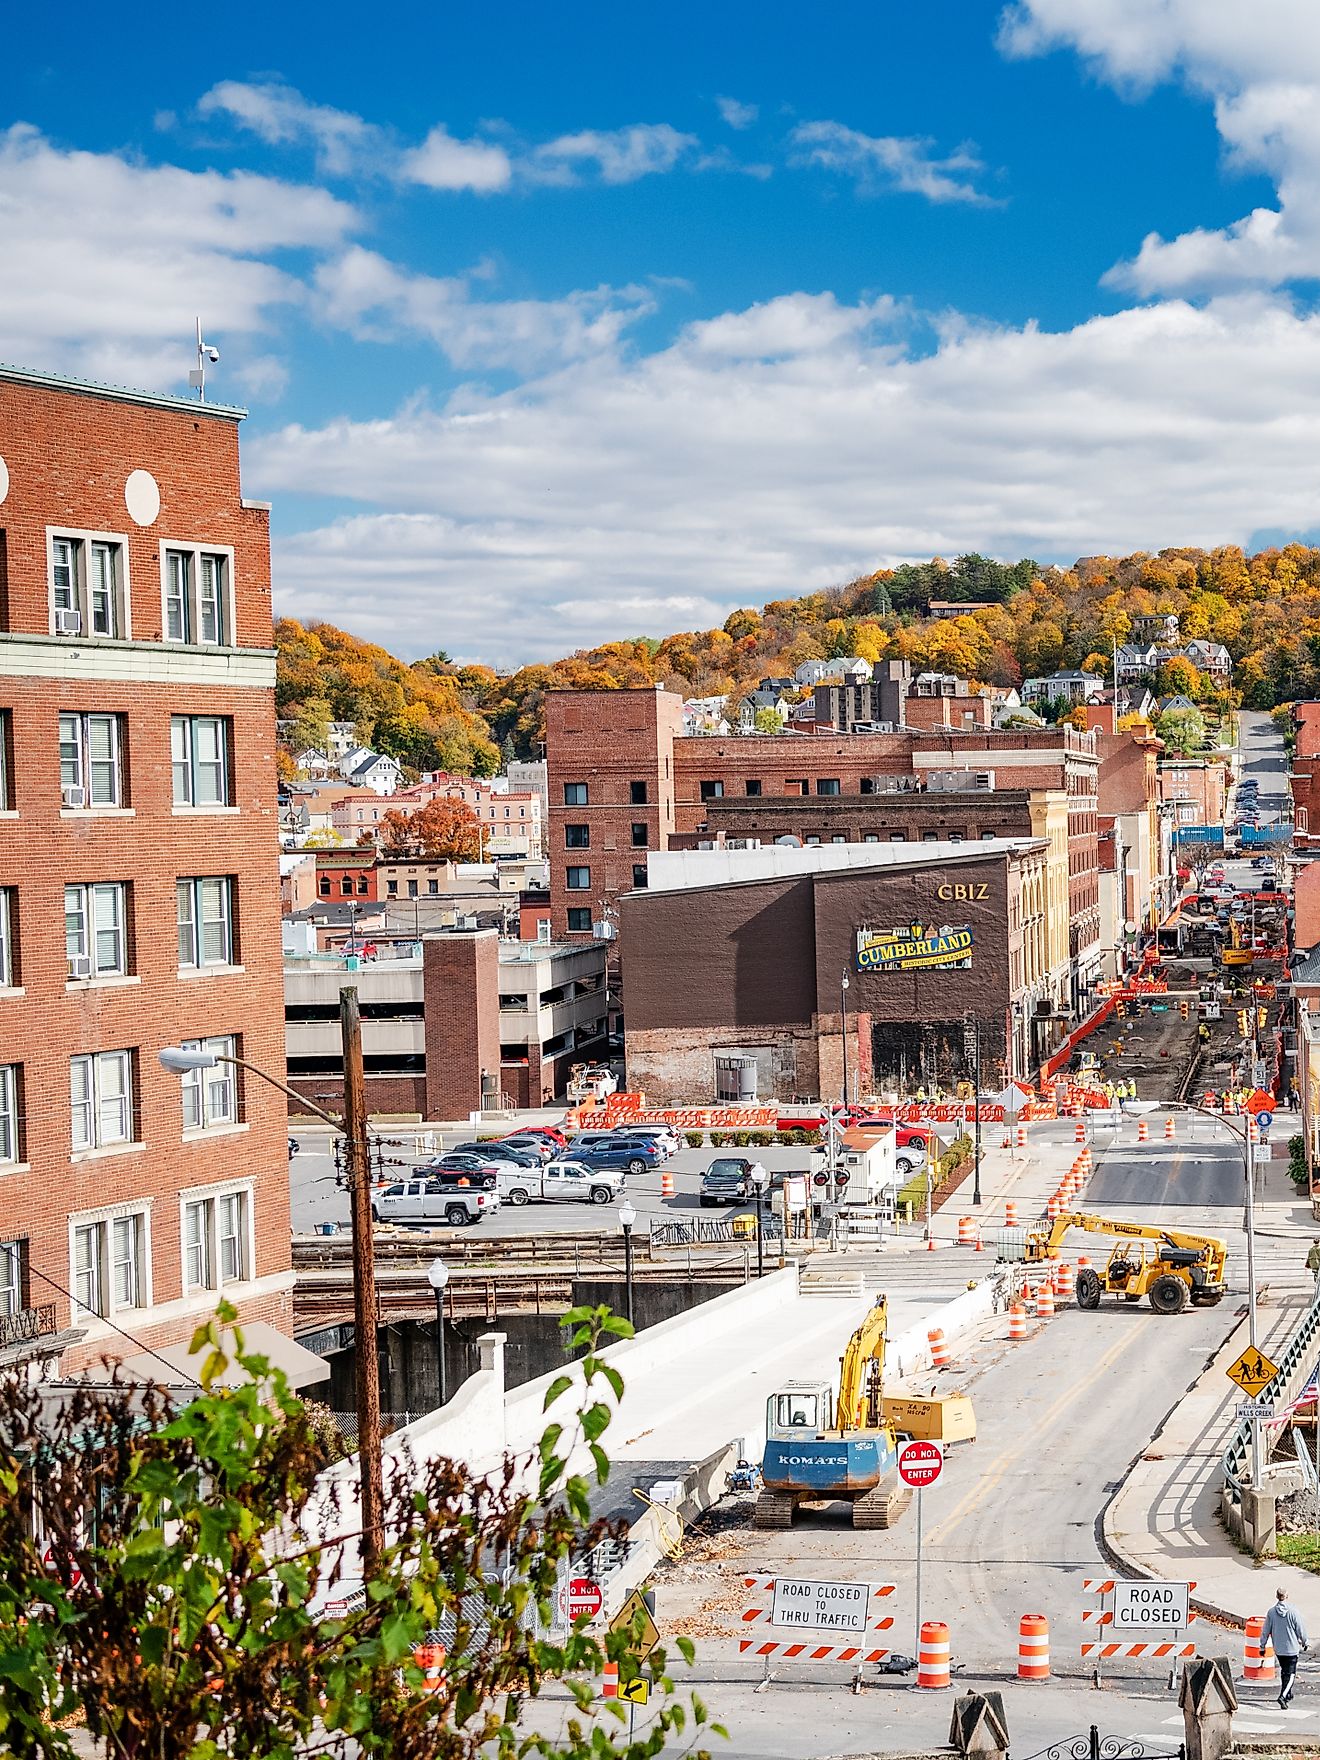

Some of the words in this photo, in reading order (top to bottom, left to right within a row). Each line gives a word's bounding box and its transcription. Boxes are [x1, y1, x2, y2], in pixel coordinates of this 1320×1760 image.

[938, 883, 989, 900] CBIZ
[858, 931, 971, 966] CUMBERLAND
[947, 951, 970, 960] CENTER
[779, 1456, 848, 1465] KOMATS
[905, 1451, 918, 1459] DO
[921, 1450, 936, 1458] NOT
[908, 1470, 933, 1479] ENTER
[580, 1586, 597, 1594] NOT
[783, 1585, 811, 1597] ROAD
[817, 1587, 861, 1600] CLOSED
[1130, 1589, 1173, 1603] ROAD
[816, 1600, 826, 1610] TO
[781, 1610, 809, 1623] THRU
[815, 1612, 858, 1626] TRAFFIC
[1120, 1608, 1181, 1622] CLOSED
